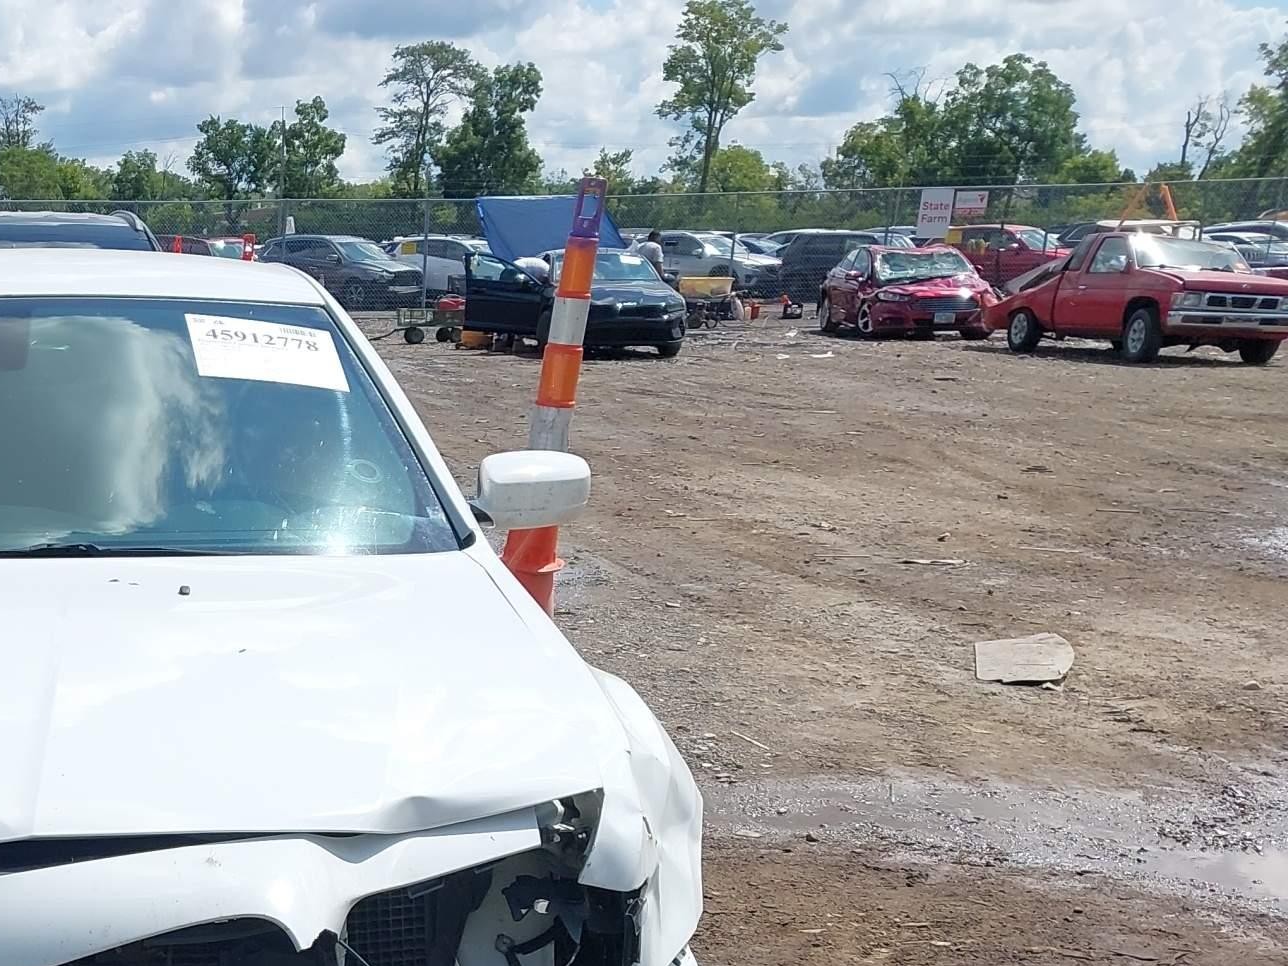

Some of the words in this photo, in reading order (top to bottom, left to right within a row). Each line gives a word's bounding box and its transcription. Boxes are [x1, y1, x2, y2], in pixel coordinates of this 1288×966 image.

[922, 202, 950, 211] State
[921, 214, 948, 223] Farm
[205, 328, 319, 352] 45912778
